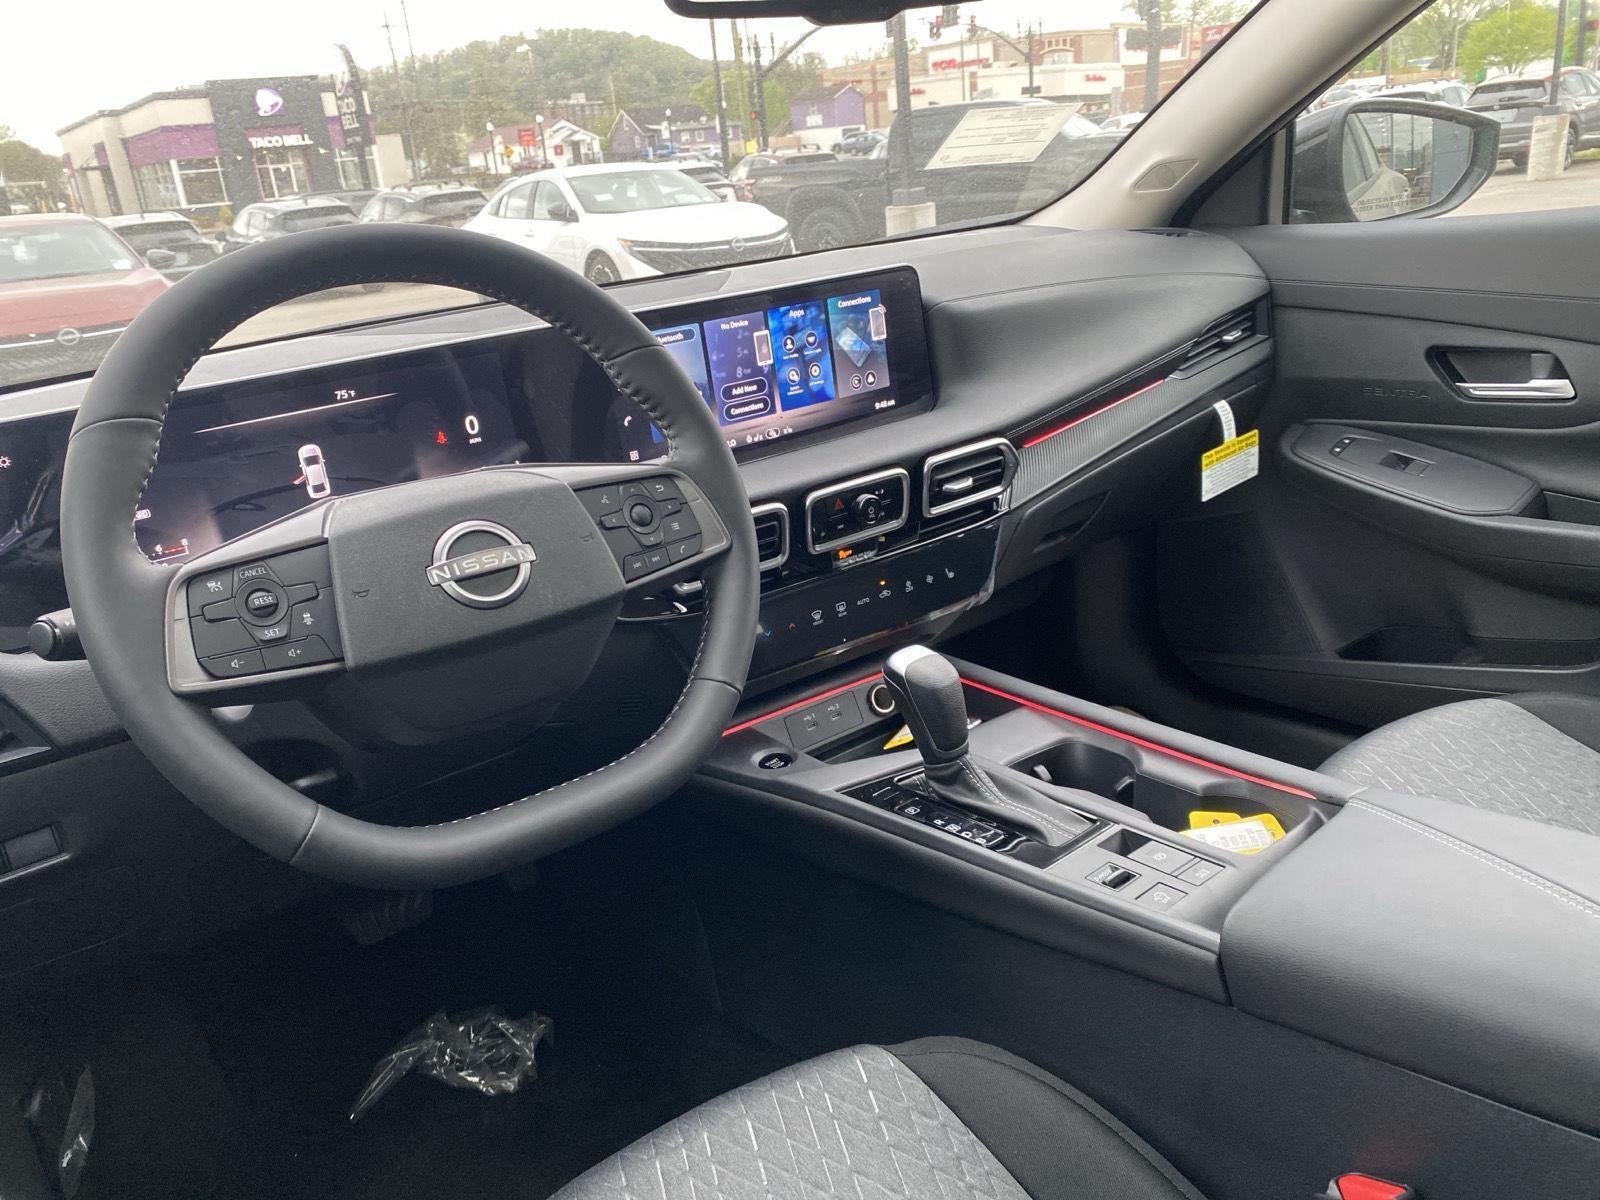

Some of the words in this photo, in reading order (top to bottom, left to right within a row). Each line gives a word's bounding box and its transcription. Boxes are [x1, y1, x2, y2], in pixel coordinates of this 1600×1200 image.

[249, 136, 283, 148] TACO
[283, 134, 314, 146] BELL
[837, 296, 871, 308] Connections
[789, 309, 805, 318] Apps
[720, 322, 730, 331] No
[730, 320, 749, 330] Device
[732, 386, 744, 396] Add
[744, 384, 758, 393] New
[730, 401, 764, 415] Connections
[464, 415, 479, 435] 0
[155, 544, 163, 552] 6
[181, 538, 188, 546] 8
[430, 547, 535, 583] NISSAN
[239, 567, 266, 579] CANCEL
[857, 597, 870, 606] AUTO
[264, 628, 280, 638] SET
